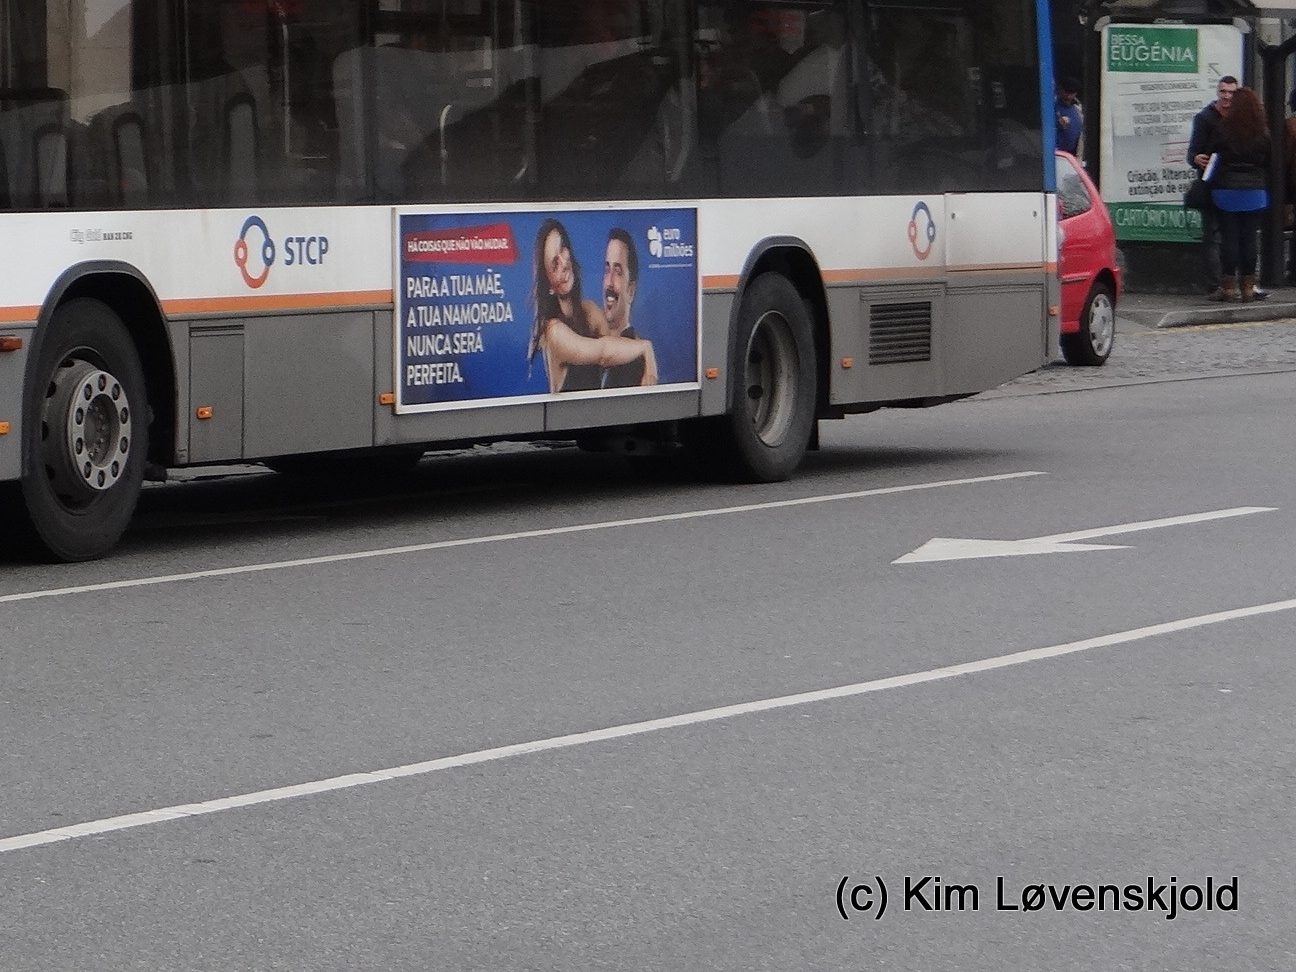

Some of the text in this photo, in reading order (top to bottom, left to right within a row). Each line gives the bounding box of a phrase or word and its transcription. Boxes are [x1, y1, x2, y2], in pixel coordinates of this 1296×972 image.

[1111, 34, 1146, 46] BESSA
[1111, 42, 1194, 62] EUGÉNIA
[1165, 183, 1176, 193] de
[663, 228, 680, 241] euro
[284, 236, 329, 266] STCP
[407, 238, 418, 252] HÁ
[419, 239, 441, 252] COISAS
[441, 239, 456, 254] QUE
[456, 236, 470, 251] NÃO
[470, 236, 484, 250] VÃO
[663, 242, 694, 258] milhões
[407, 268, 504, 298] PARA A TUA MÃE,
[407, 302, 514, 327] A TUA NAMORADA
[407, 326, 484, 357] NUNCA SERÁ
[407, 362, 464, 386] PERFEITA.
